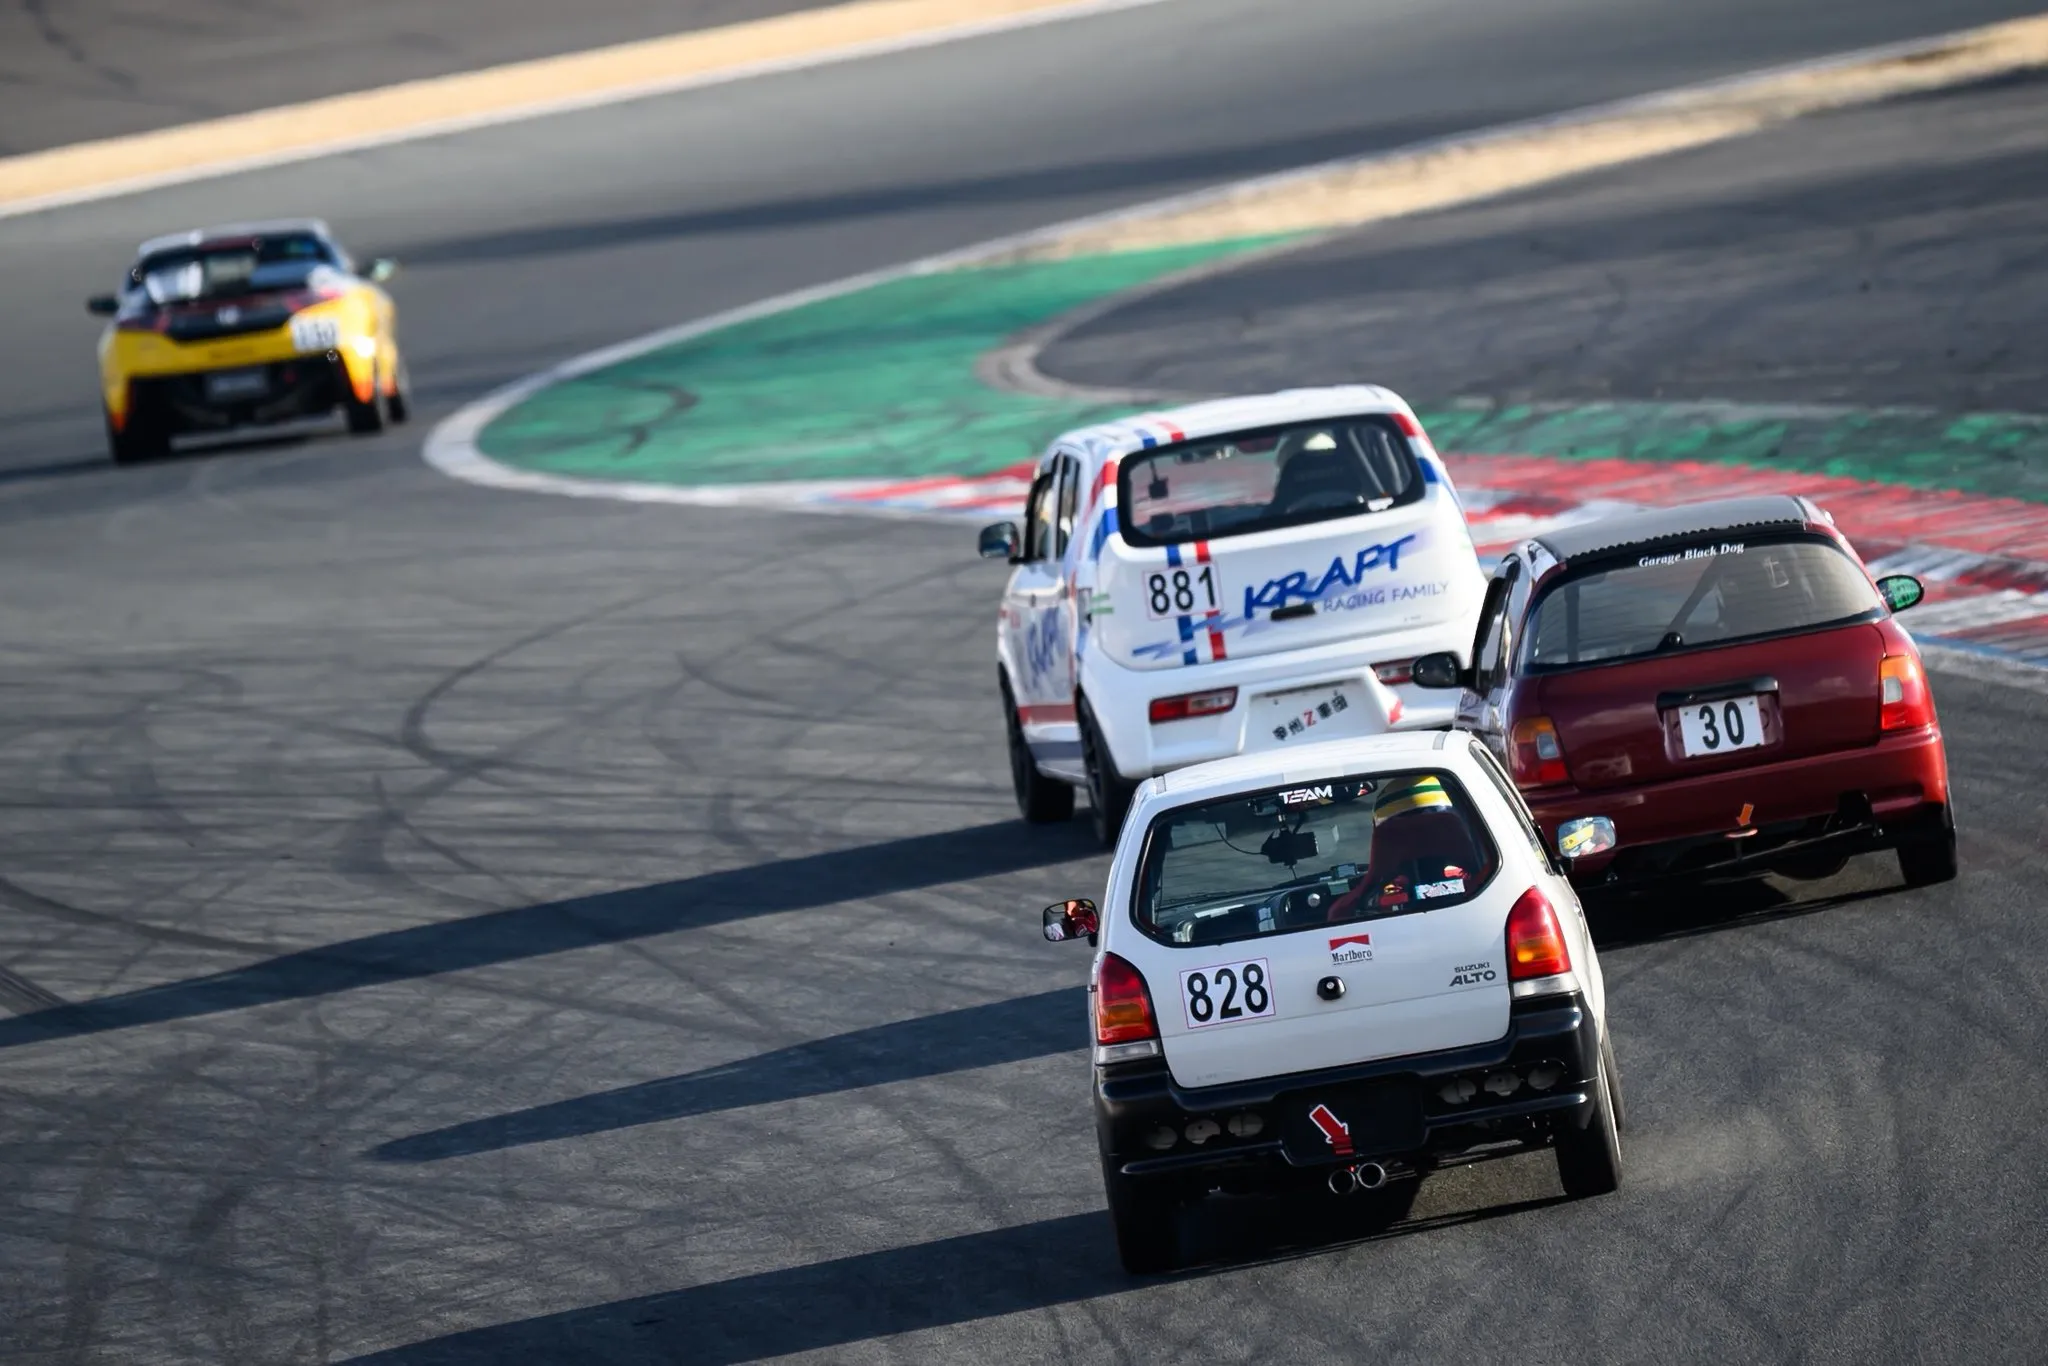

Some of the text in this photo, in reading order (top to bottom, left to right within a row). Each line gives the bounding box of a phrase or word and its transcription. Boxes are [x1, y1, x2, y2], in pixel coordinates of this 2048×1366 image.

[1638, 542, 1744, 568] Garage Black Dog
[1149, 566, 1215, 616] 881
[1323, 580, 1450, 613] RACING FAMILY
[1699, 701, 1744, 750] 30
[1278, 784, 1333, 805] TEAM
[1331, 948, 1373, 963] Marlboro
[1454, 961, 1491, 974] SUZUKI
[1448, 969, 1497, 987] ALTO
[1187, 963, 1269, 1022] 828
